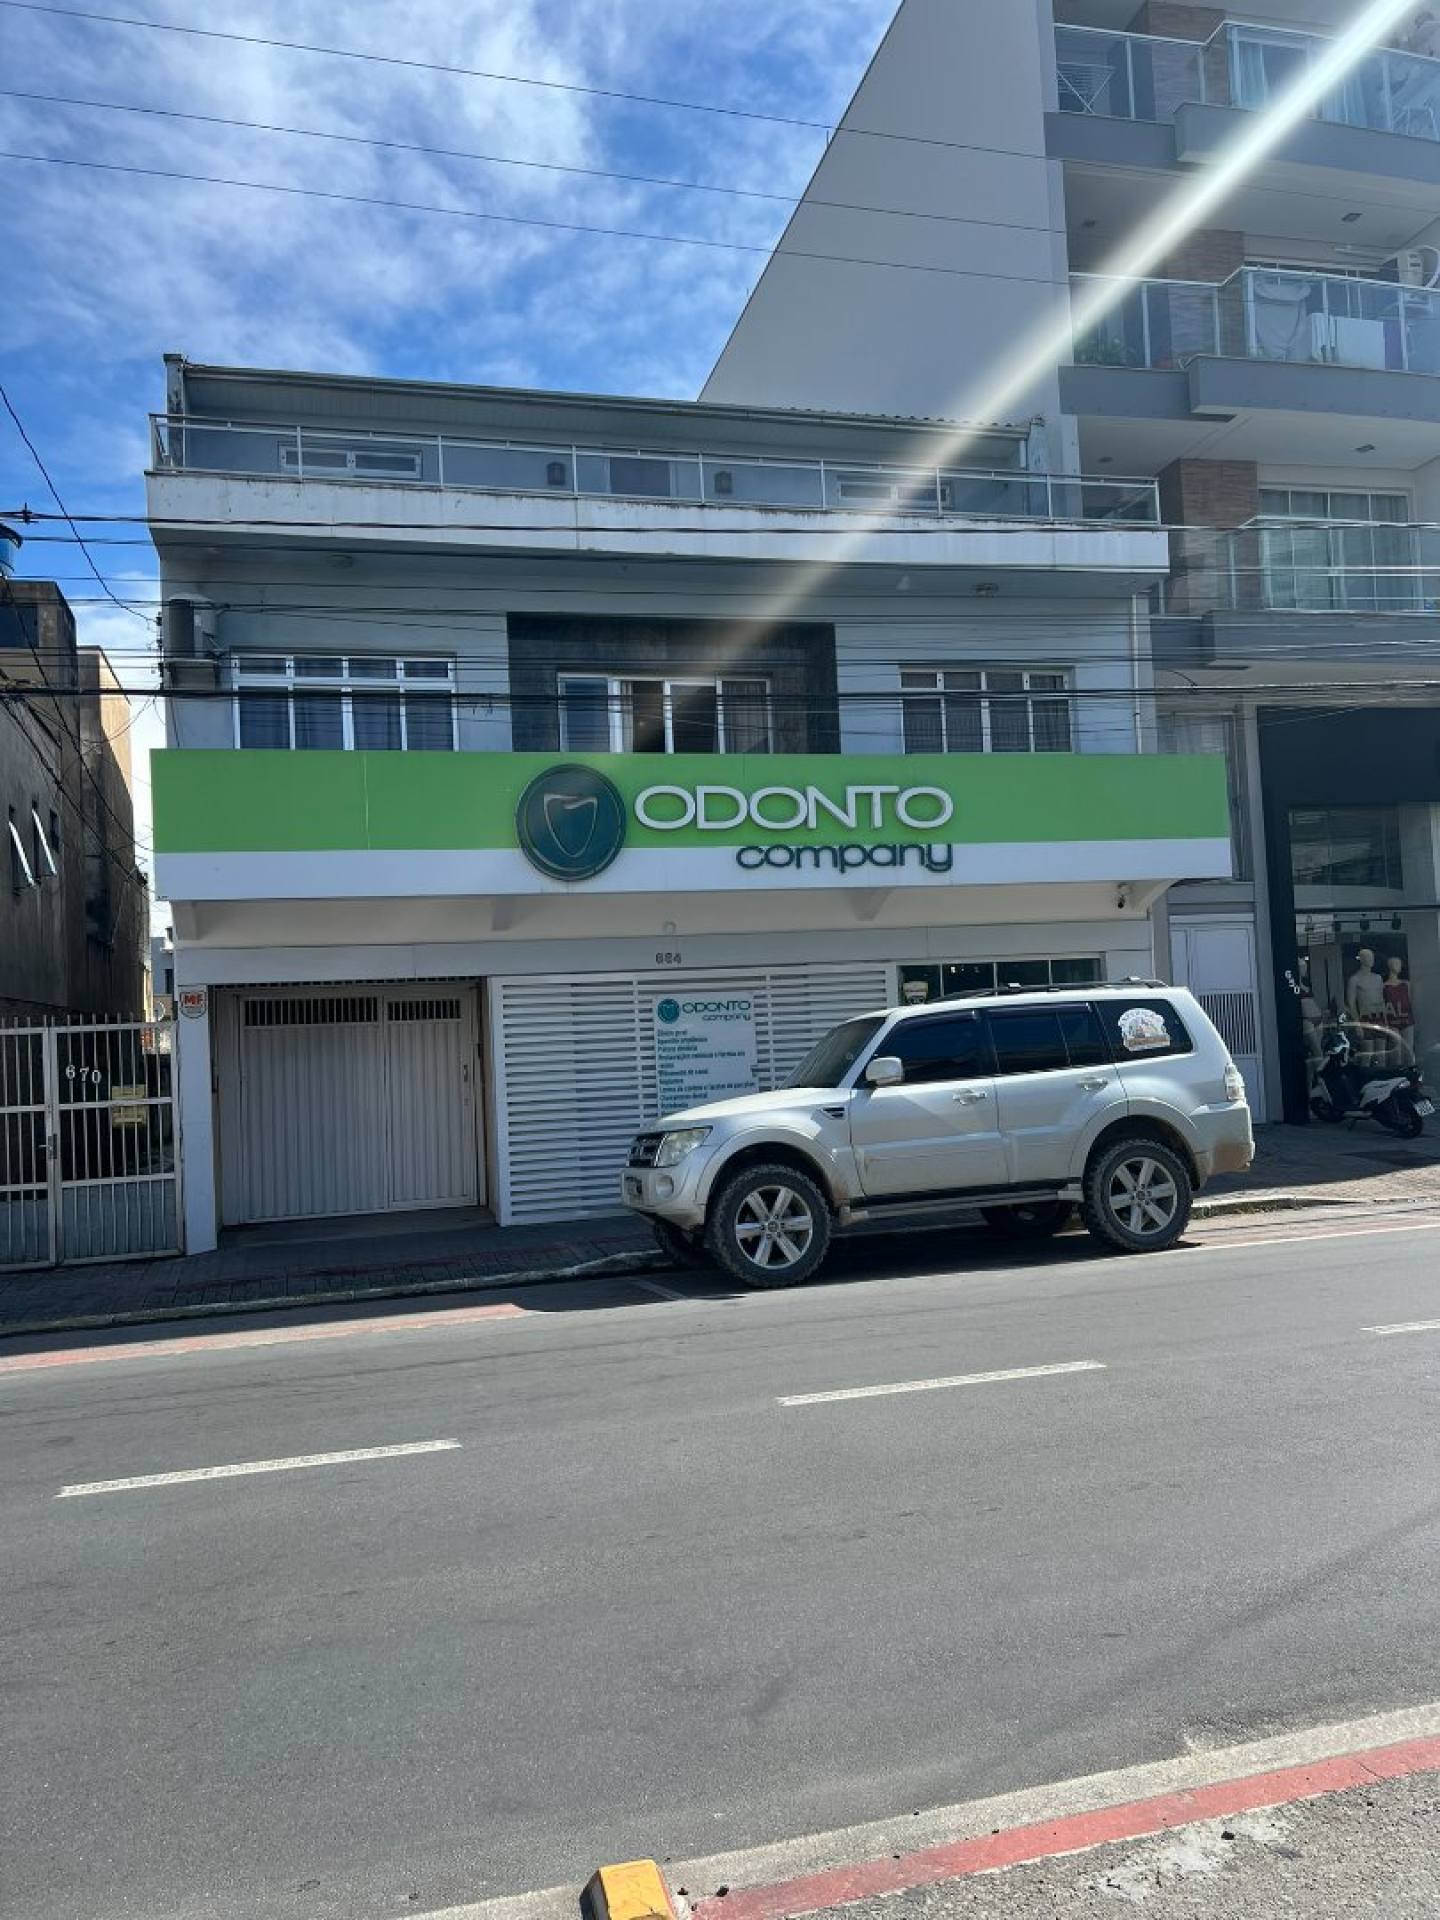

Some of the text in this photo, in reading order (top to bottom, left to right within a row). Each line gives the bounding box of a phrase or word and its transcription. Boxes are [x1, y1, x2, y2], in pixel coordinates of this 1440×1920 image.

[634, 785, 953, 830] ODONTO
[736, 843, 952, 873] company
[682, 1000, 751, 1013] ODONTO
[65, 1064, 102, 1084] 670
